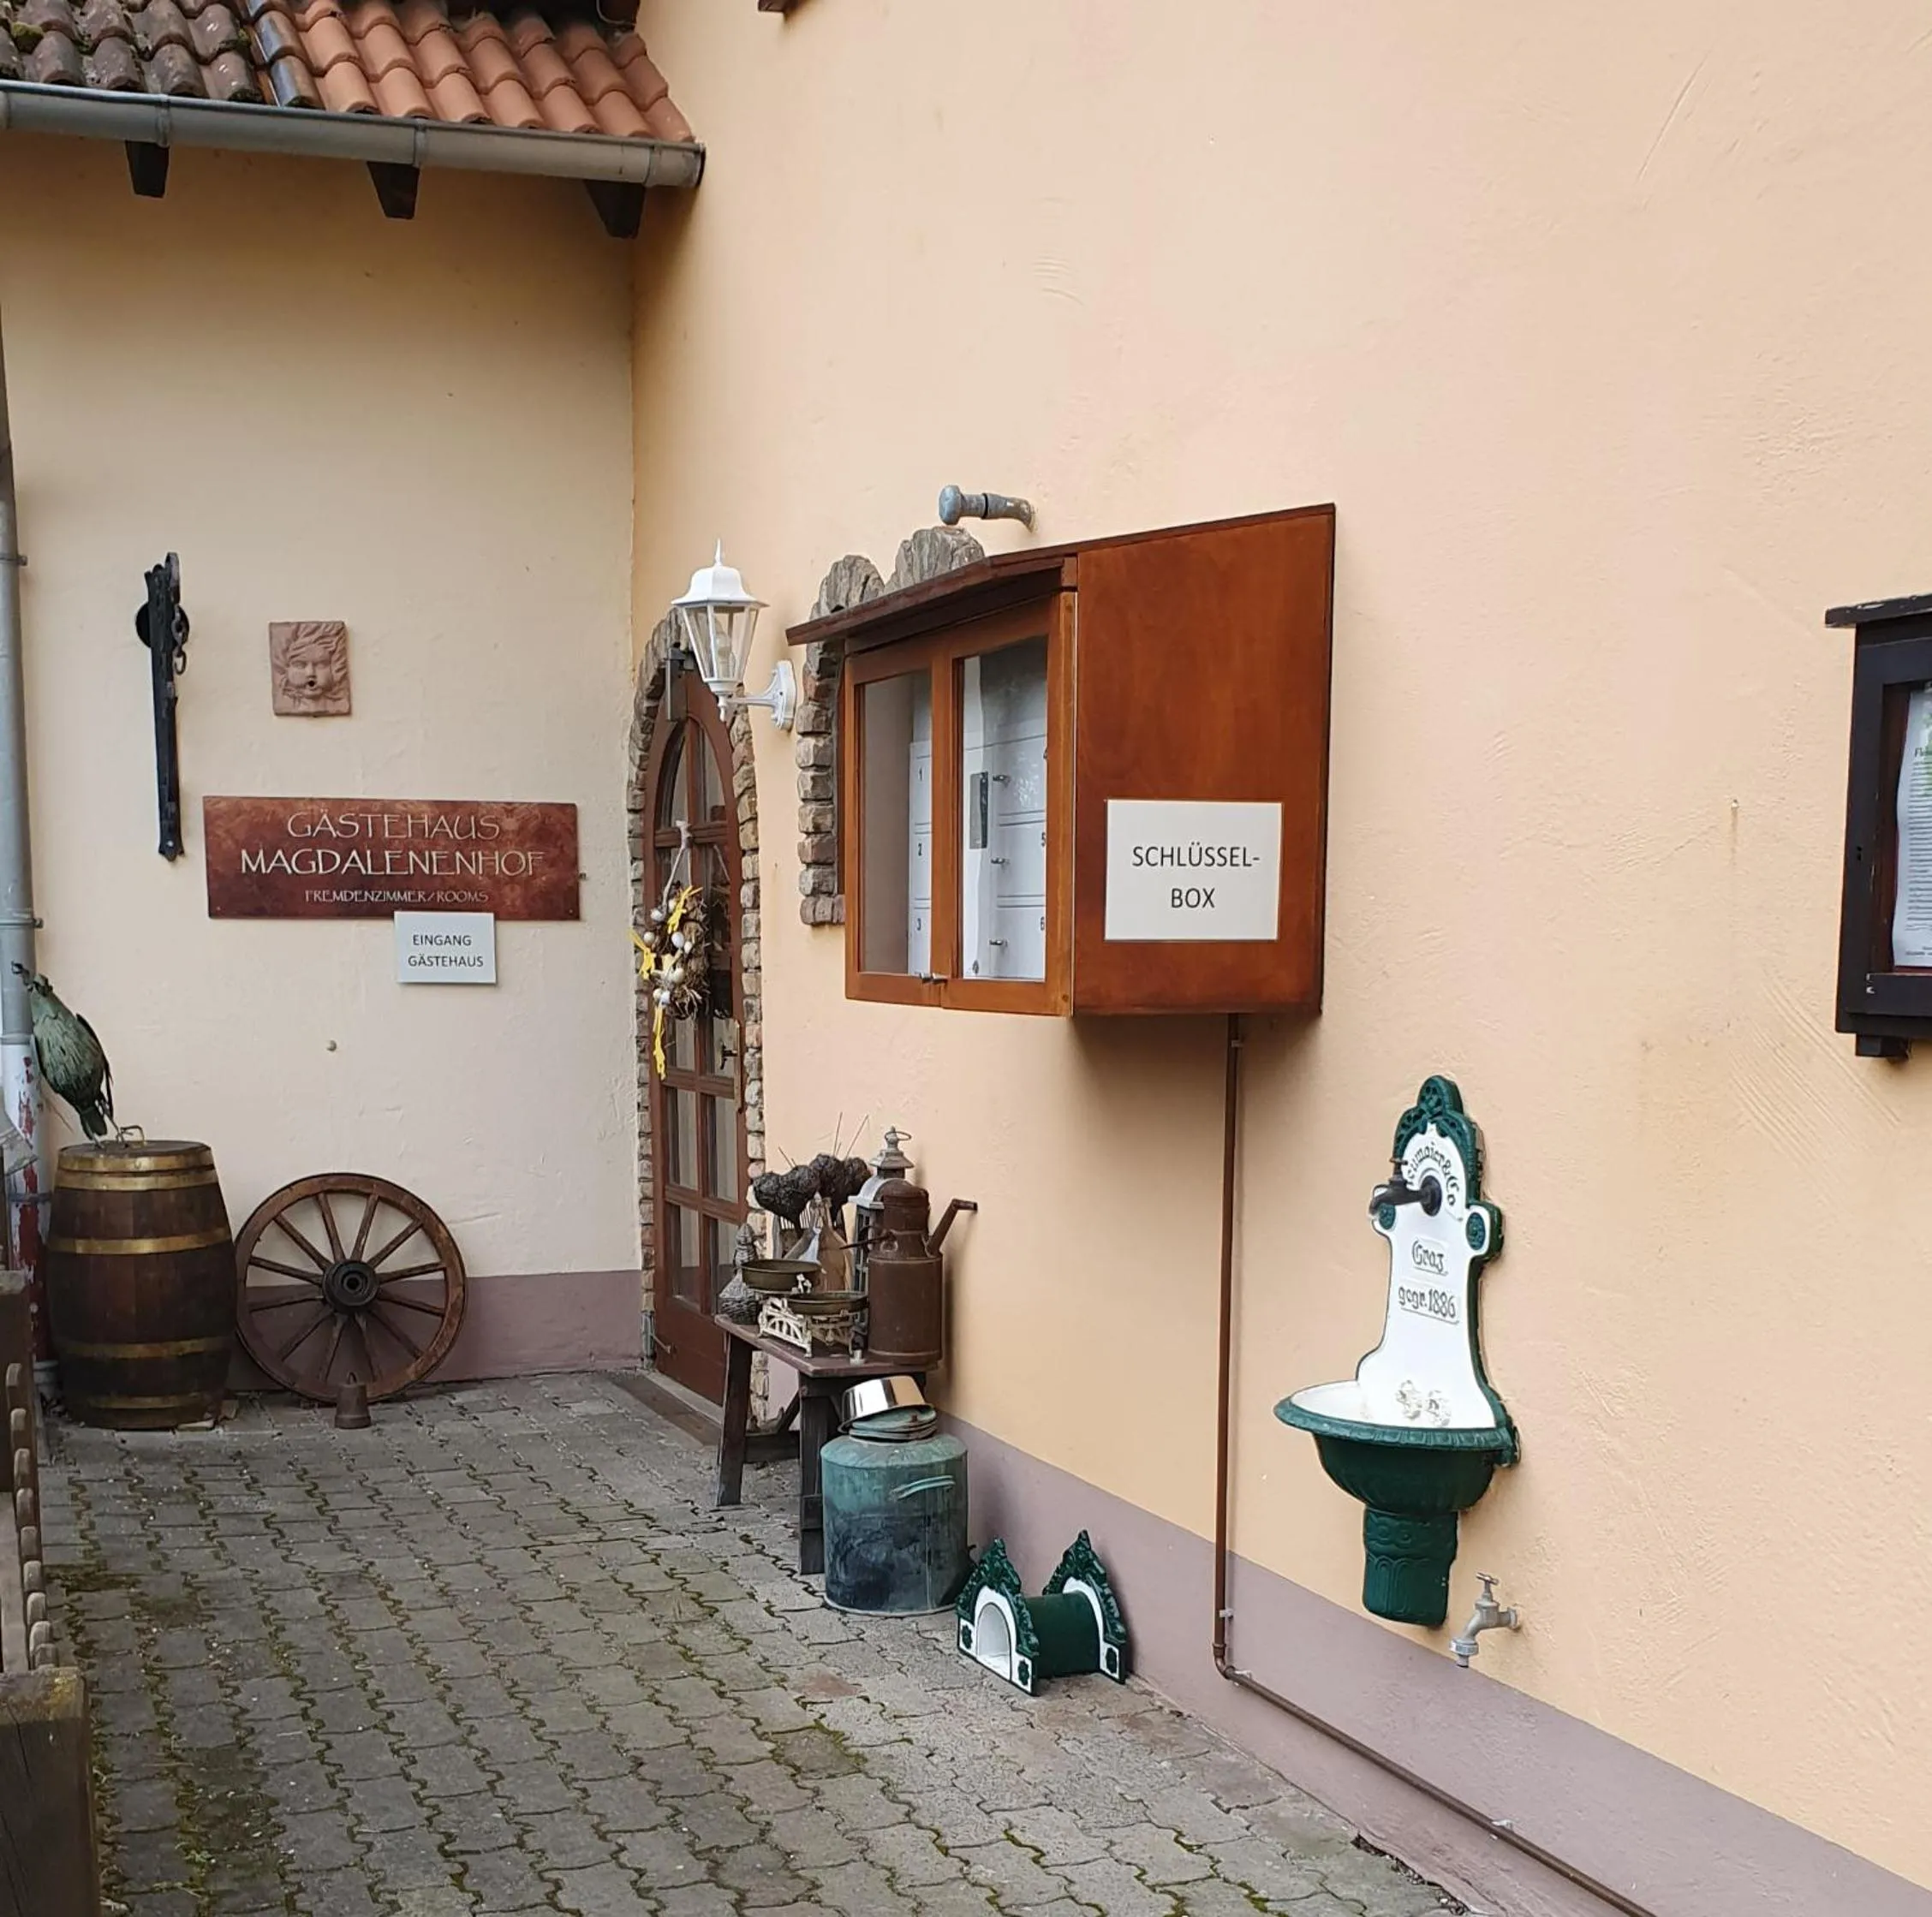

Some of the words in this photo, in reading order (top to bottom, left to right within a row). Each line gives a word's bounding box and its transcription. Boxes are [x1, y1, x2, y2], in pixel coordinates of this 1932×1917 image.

[287, 809, 501, 841] GÄSTEHAUS
[240, 848, 546, 877] MAGDALENENHOF
[1131, 841, 1261, 867] SCHLÜSSEL-
[1171, 887, 1216, 908] BOX
[412, 934, 473, 947] EINGANG
[407, 954, 485, 967] GÄSTEHAUS
